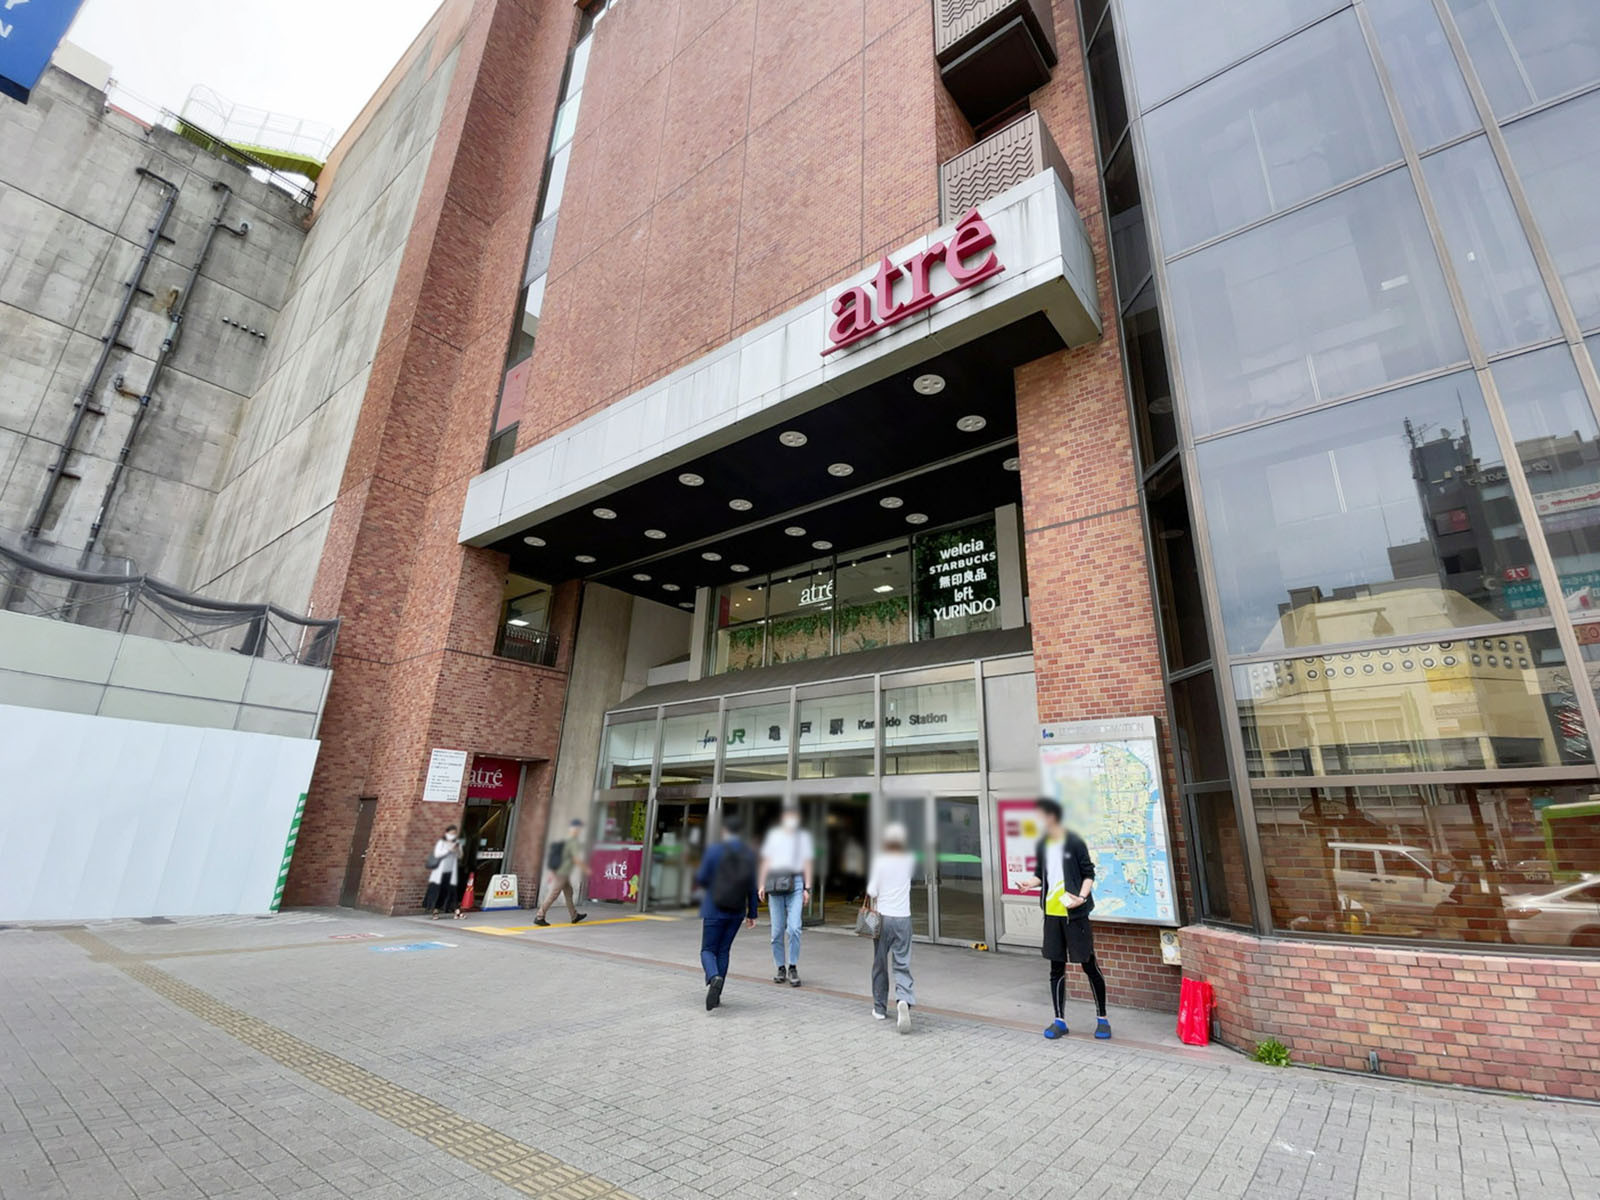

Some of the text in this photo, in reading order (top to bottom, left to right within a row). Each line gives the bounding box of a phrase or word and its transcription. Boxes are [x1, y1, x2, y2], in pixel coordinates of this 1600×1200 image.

[828, 207, 1000, 348] atré
[939, 538, 985, 560] welcia
[928, 551, 997, 575] STARBUCKS
[938, 567, 988, 589] 無印良品
[933, 597, 996, 621] YURINDO
[908, 712, 948, 726] Station
